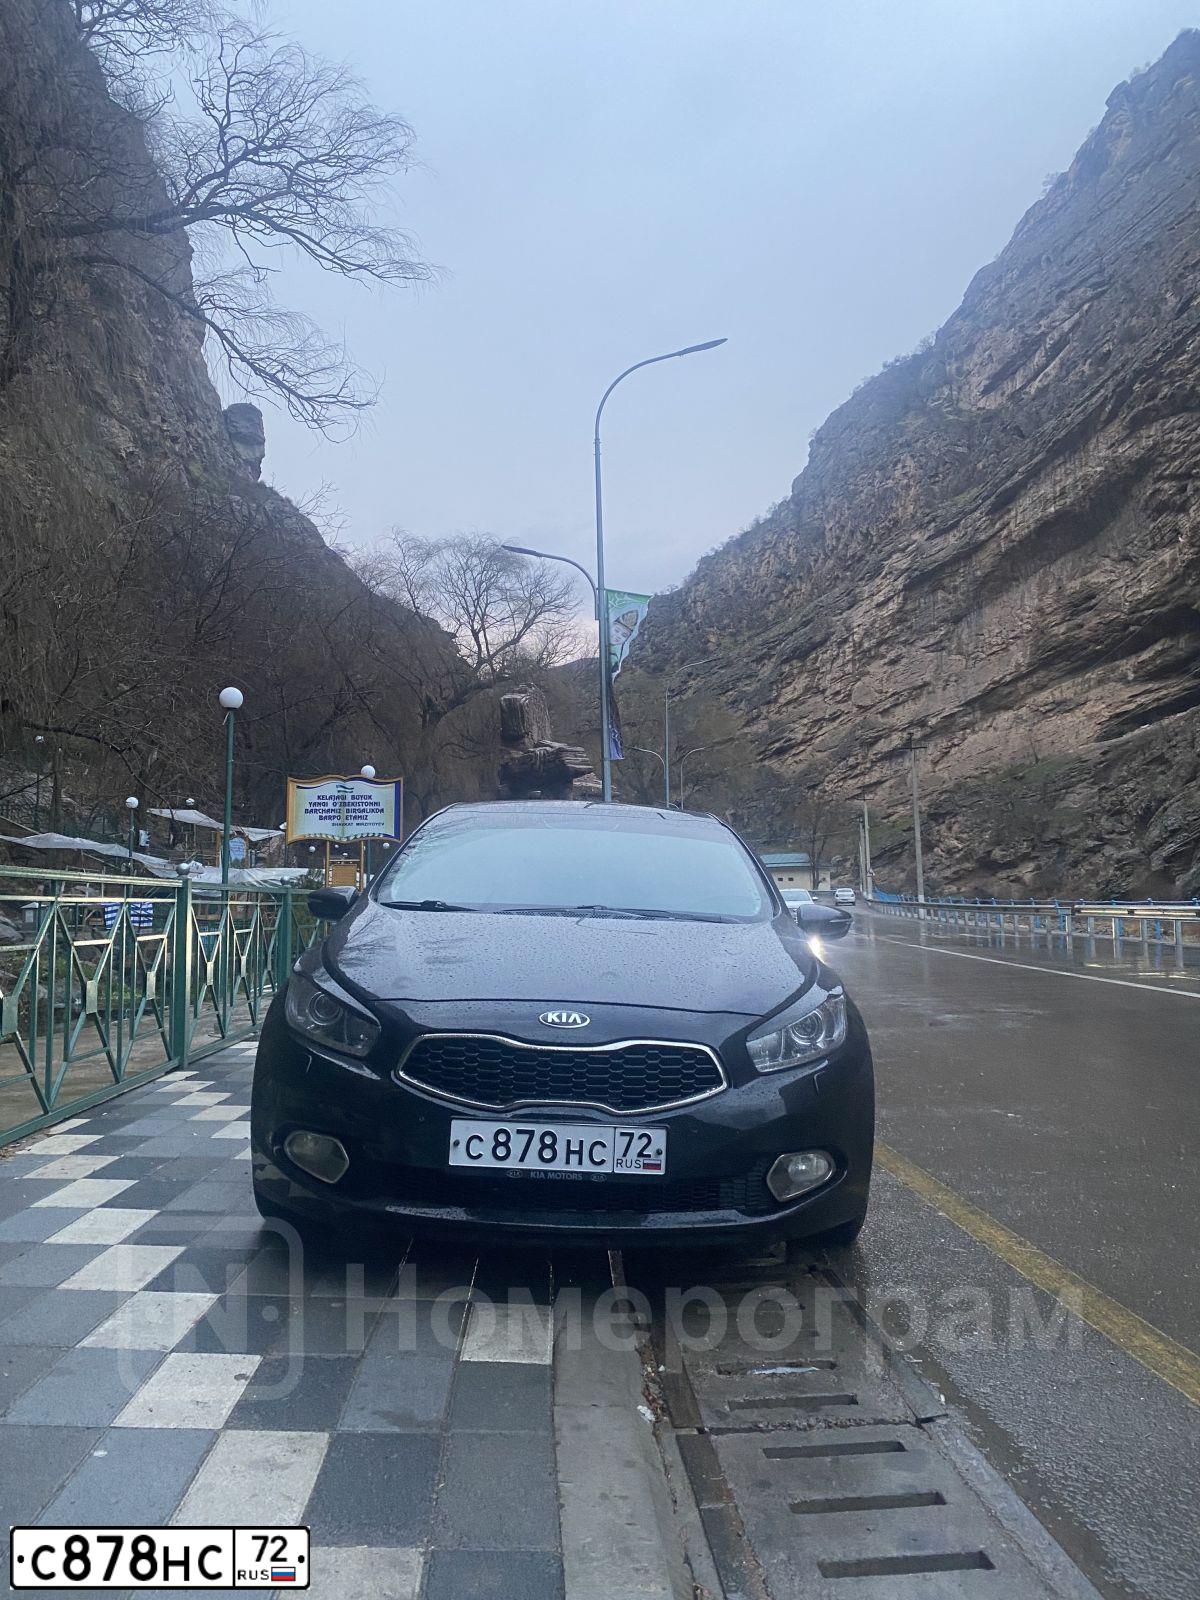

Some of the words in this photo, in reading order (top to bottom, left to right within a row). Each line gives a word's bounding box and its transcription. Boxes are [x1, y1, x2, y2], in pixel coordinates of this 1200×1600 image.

[547, 1012, 582, 1024] KIA
[619, 1131, 653, 1159] 72
[615, 1158, 642, 1169] RUS
[530, 1171, 546, 1179] KIA
[547, 1172, 583, 1181] MOTORS
